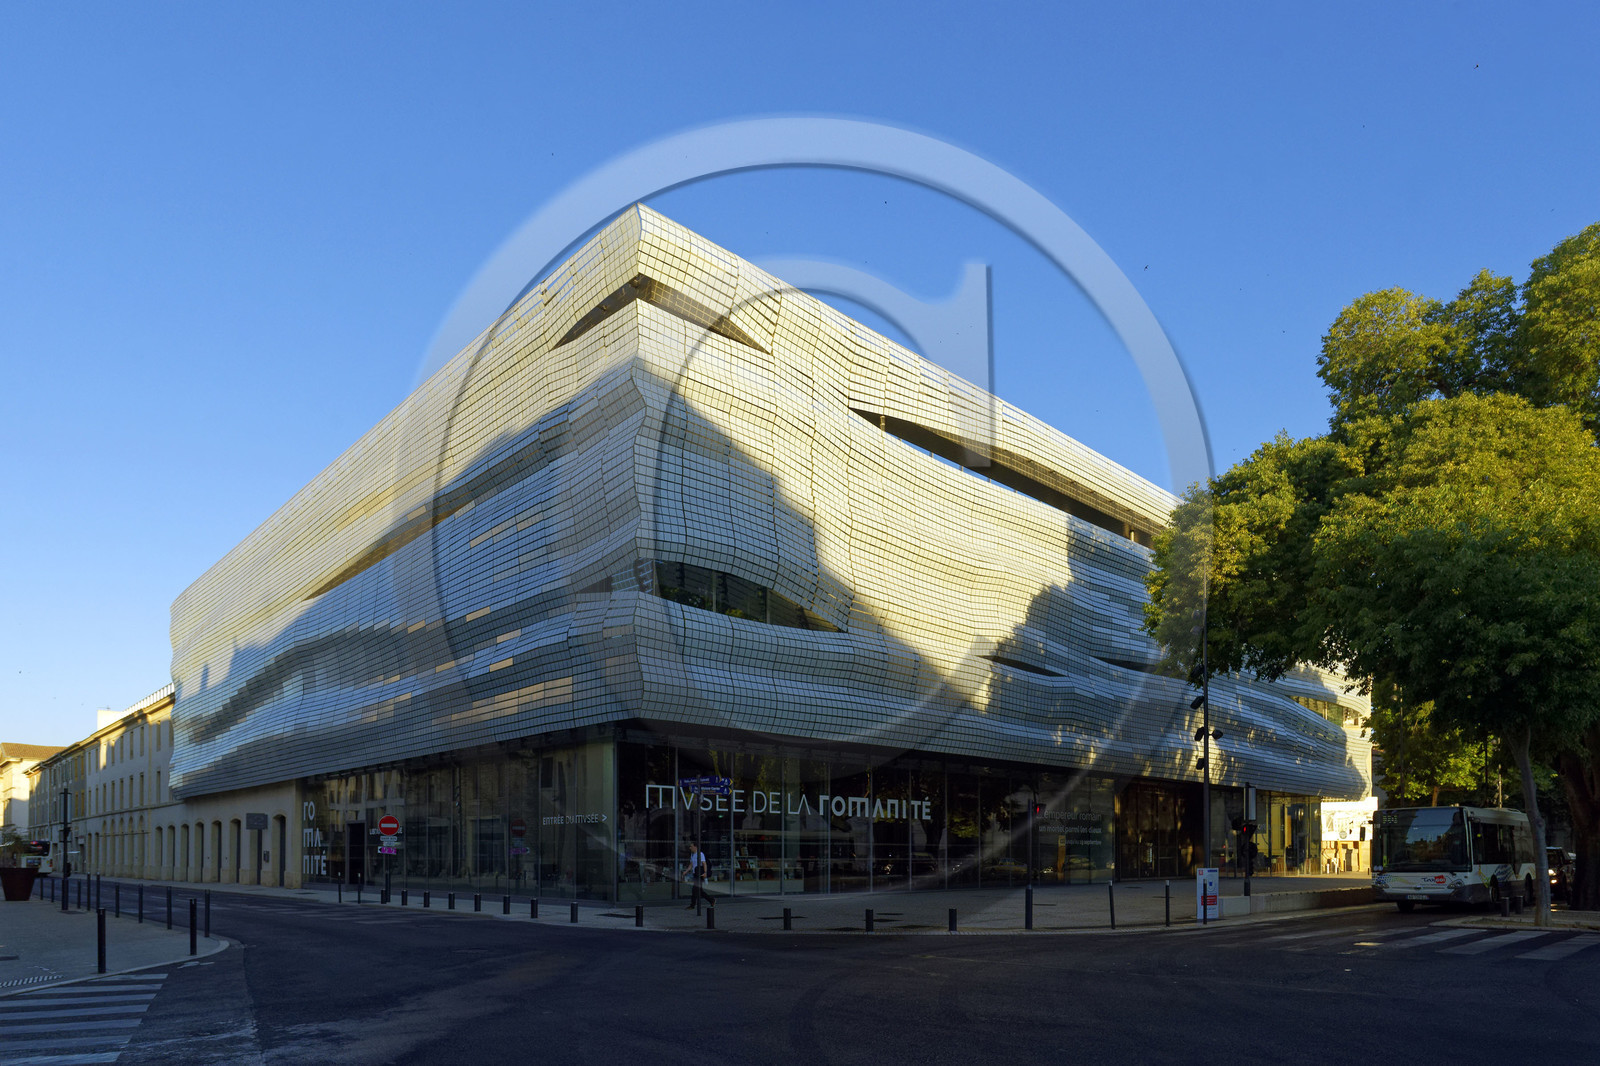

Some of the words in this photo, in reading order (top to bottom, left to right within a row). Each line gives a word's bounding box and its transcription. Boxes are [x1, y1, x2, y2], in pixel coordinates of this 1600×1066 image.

[752, 790, 781, 814] DE
[787, 792, 811, 816] LA
[542, 814, 564, 826] ENTRÉE
[565, 815, 575, 825] DU
